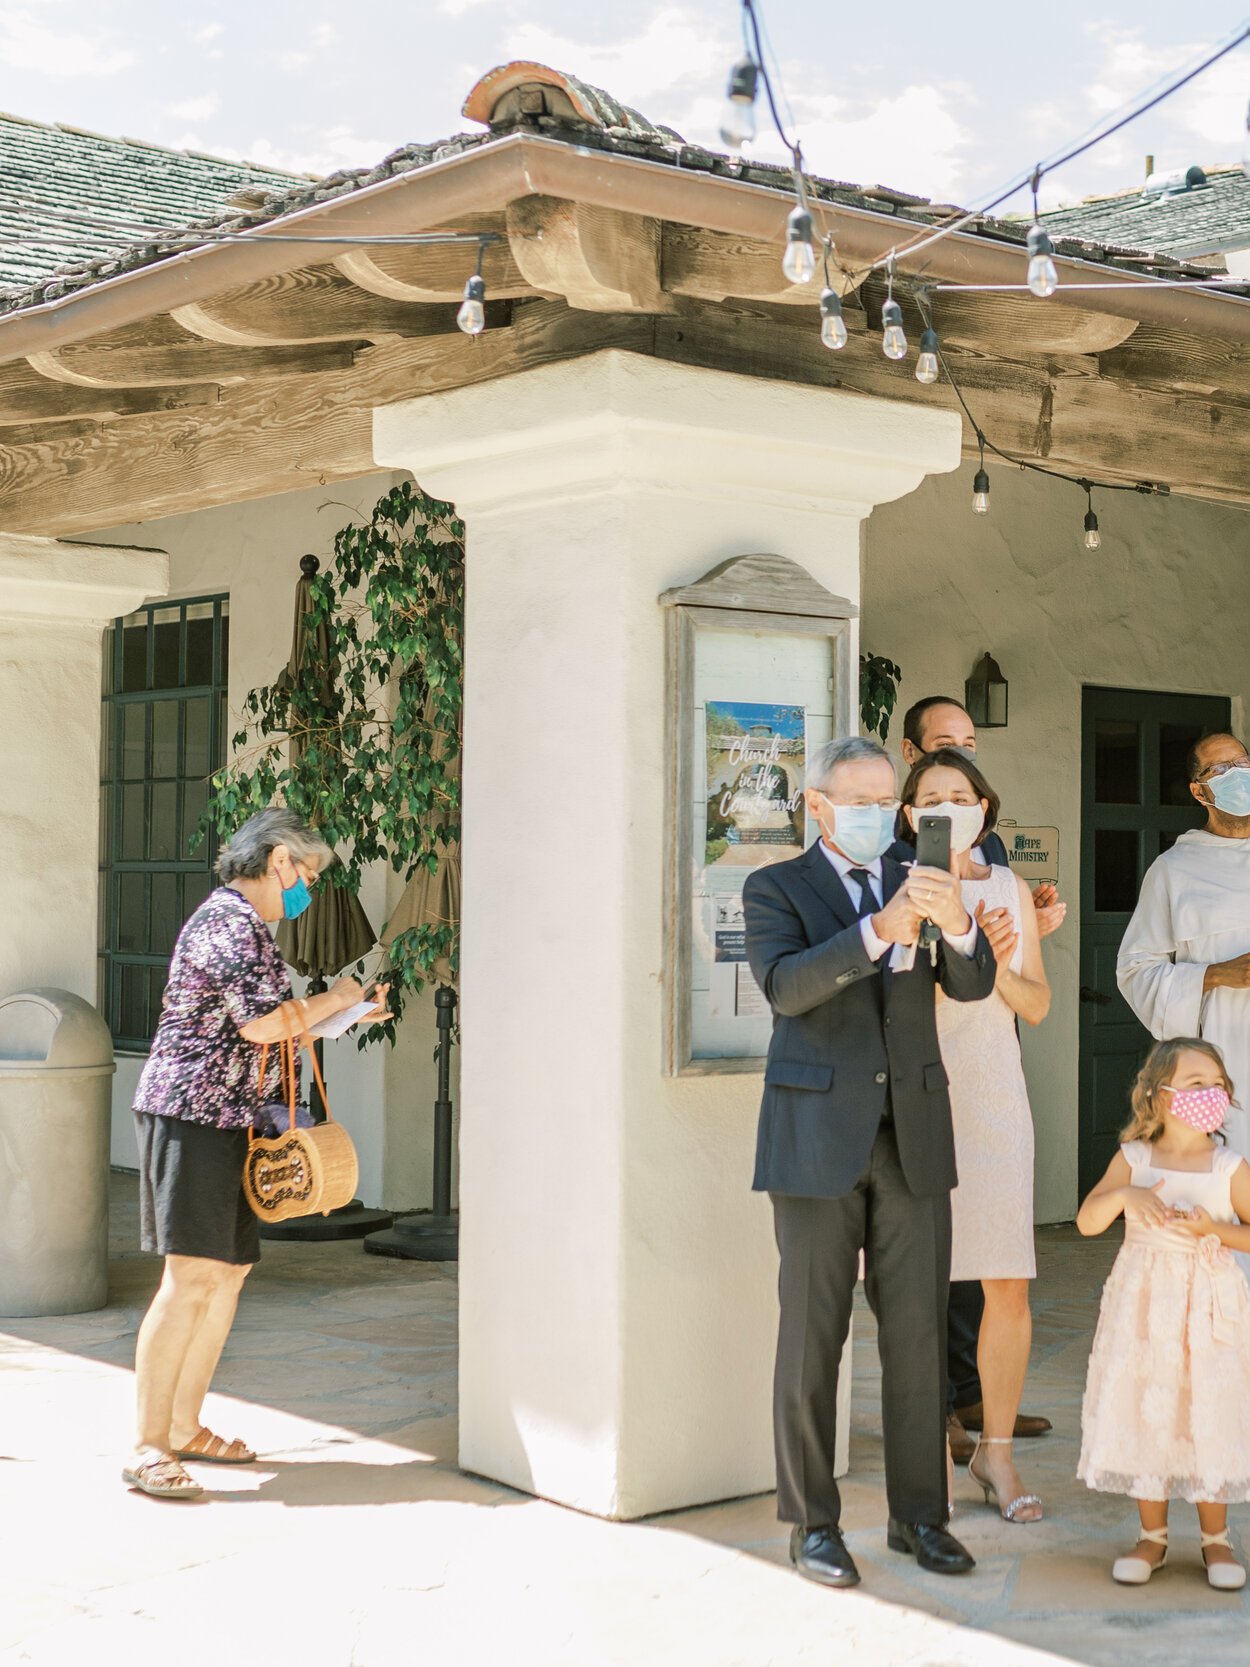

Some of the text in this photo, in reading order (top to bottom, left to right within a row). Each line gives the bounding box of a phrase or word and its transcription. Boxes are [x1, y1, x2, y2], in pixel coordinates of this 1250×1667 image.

[729, 734, 781, 766] Church
[739, 763, 780, 793] in the
[720, 791, 801, 822] Courtyard
[1009, 850, 1049, 862] MINISTRY
